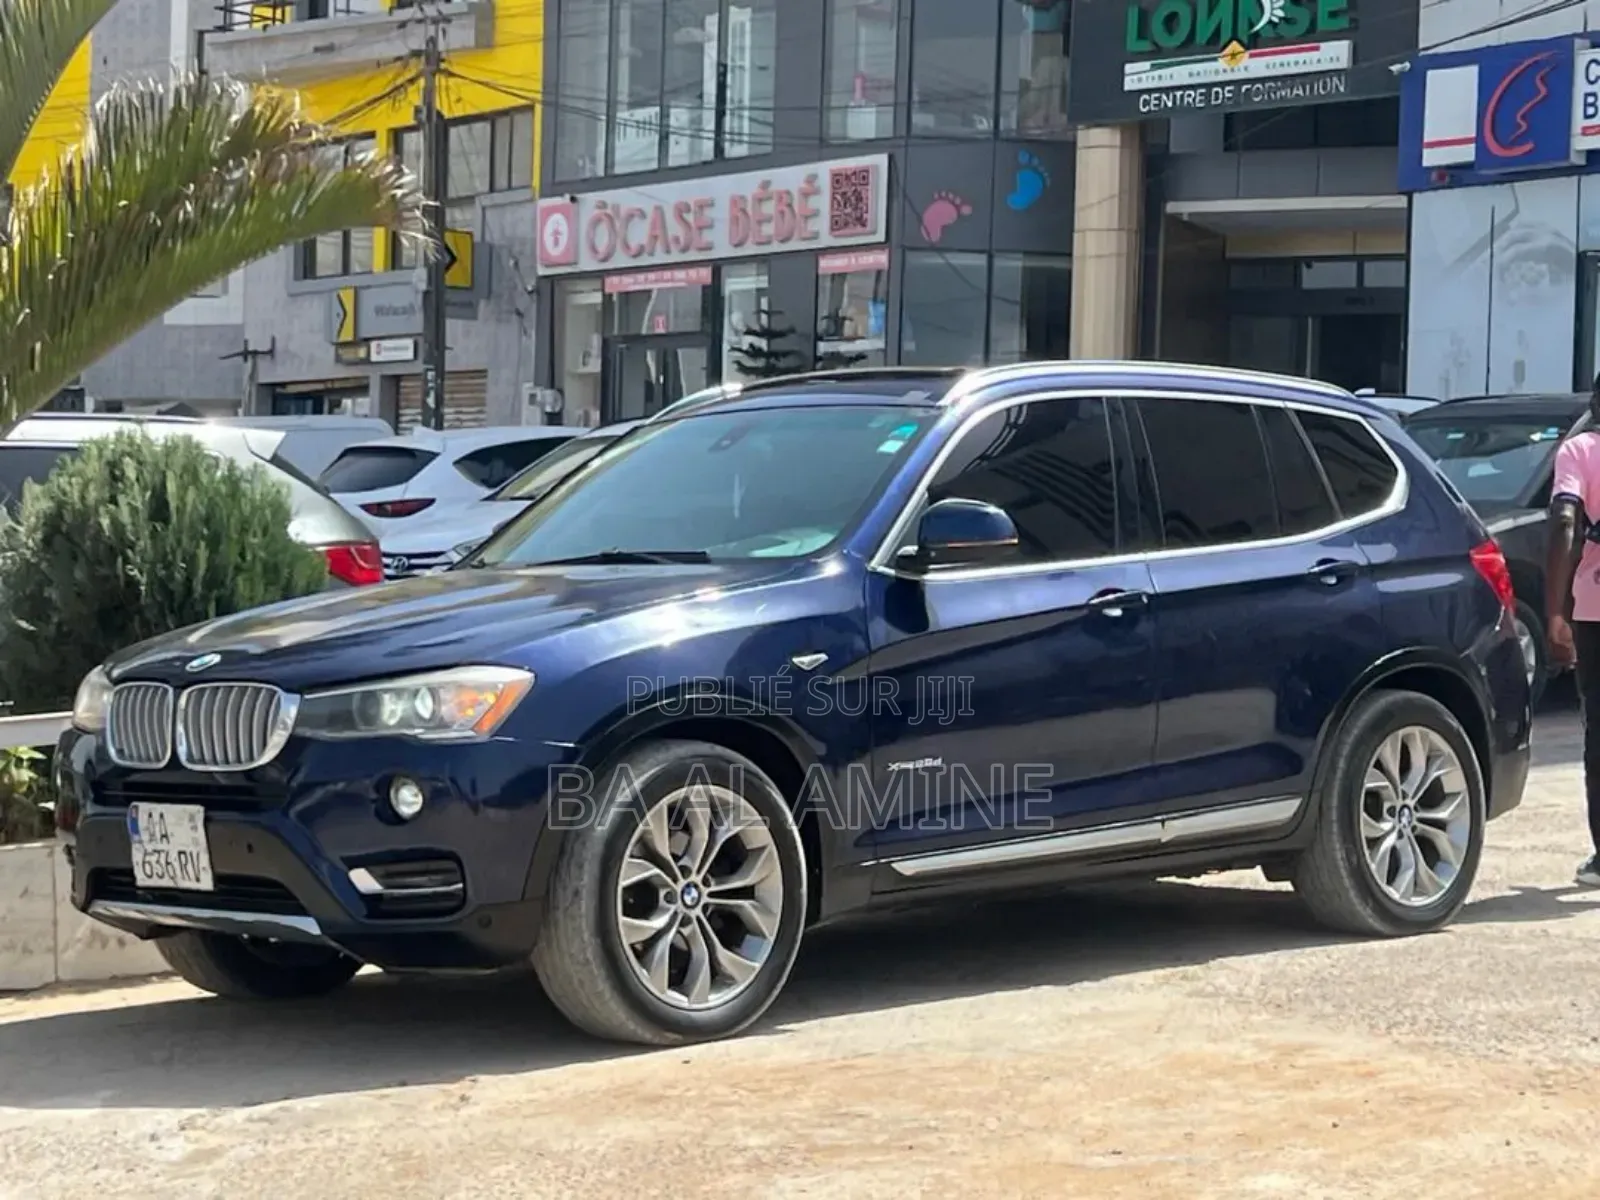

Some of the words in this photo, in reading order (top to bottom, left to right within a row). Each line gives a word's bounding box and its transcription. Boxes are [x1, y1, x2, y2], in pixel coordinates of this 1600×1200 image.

[1139, 88, 1207, 112] CENTRE
[1211, 86, 1235, 105] DE
[728, 173, 821, 248] BÉBÉ
